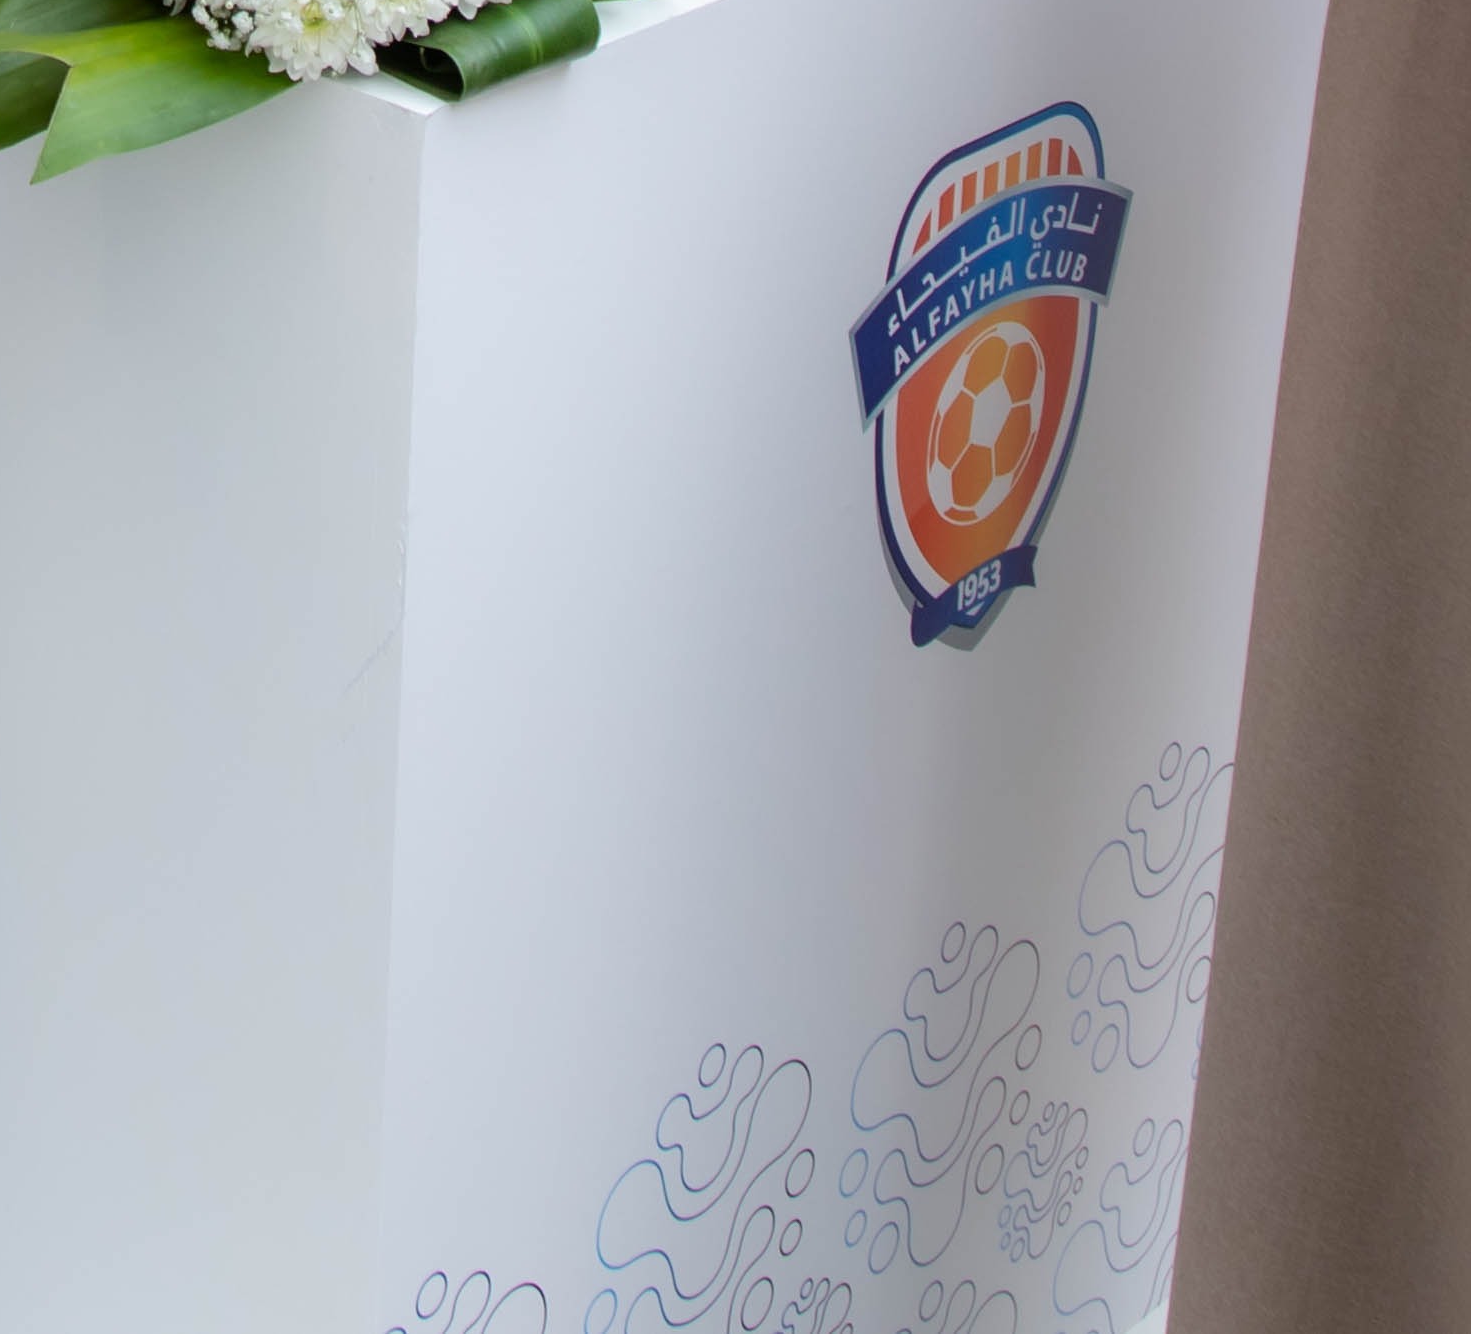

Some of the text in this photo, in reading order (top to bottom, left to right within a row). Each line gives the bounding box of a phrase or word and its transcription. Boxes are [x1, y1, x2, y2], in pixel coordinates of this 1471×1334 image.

[886, 192, 1103, 338] نادي الفيحاء
[893, 249, 1088, 377] ALFAYHA CLUB
[955, 559, 1002, 612] 1953
